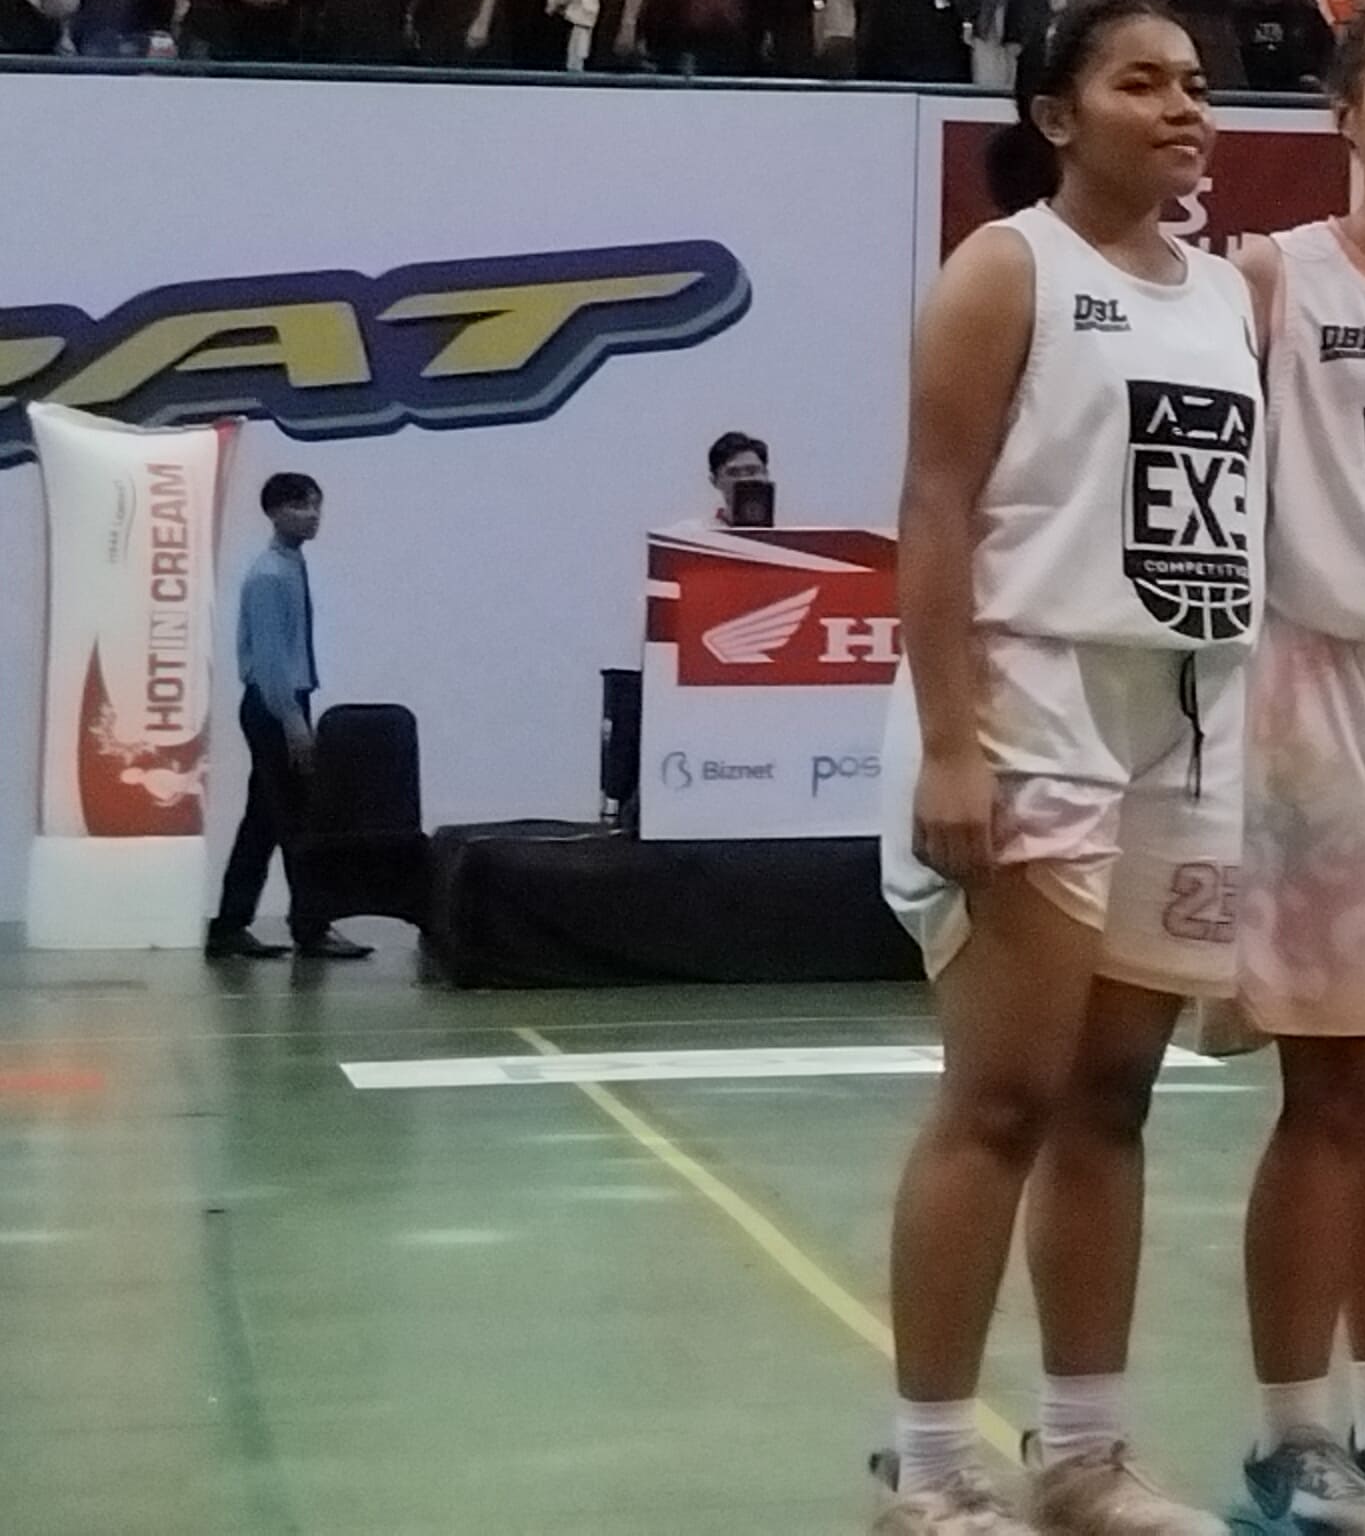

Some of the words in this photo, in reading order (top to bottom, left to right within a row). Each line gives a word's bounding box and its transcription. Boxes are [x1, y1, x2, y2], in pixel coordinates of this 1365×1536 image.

[0, 261, 722, 409] AT
[146, 462, 189, 602] CREAM
[702, 760, 774, 782] Biznet
